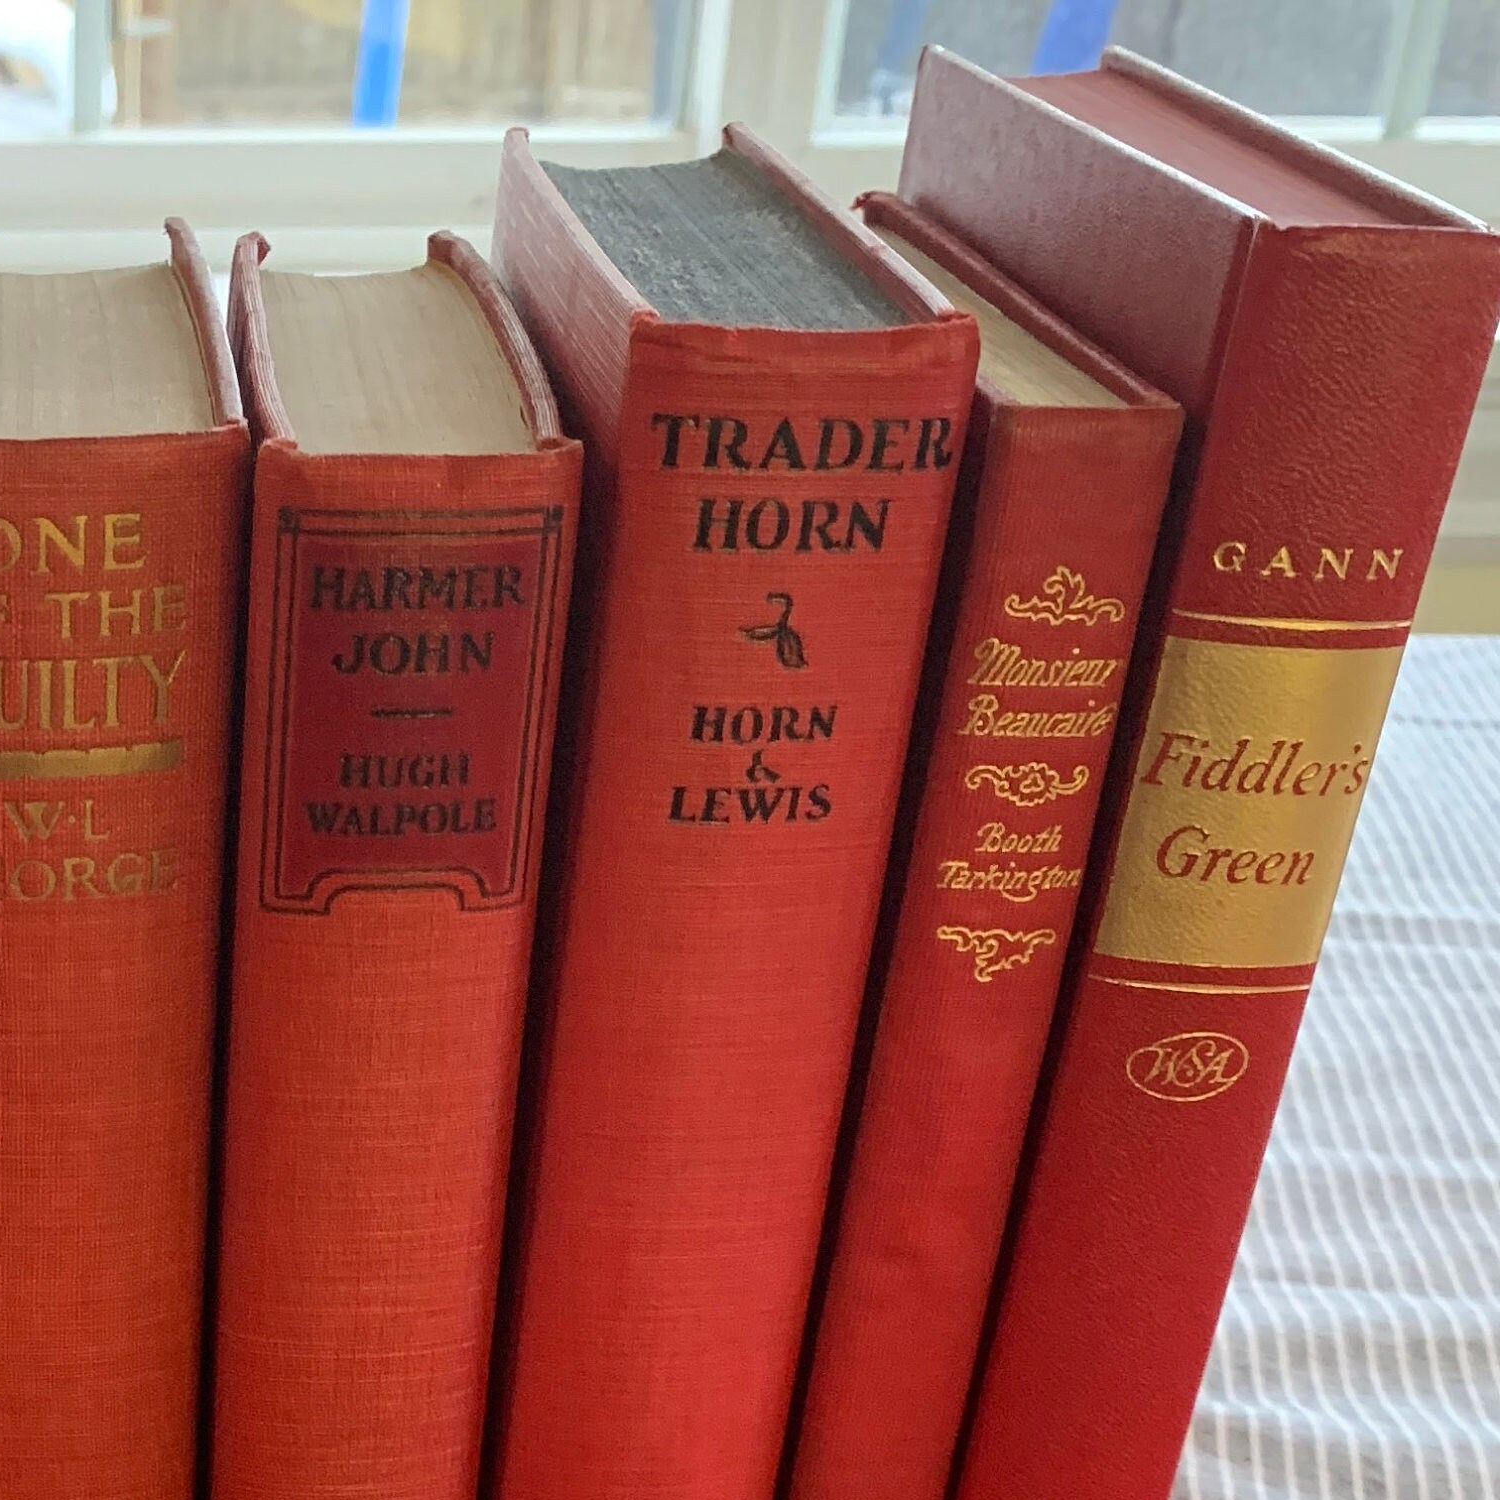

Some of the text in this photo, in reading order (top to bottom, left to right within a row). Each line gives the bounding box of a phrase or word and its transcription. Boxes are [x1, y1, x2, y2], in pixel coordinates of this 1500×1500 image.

[650, 412, 956, 473] TRADER
[692, 495, 892, 553] HORN
[1212, 541, 1405, 581] GANN
[310, 563, 526, 612] HARMER
[44, 584, 187, 640] THE
[332, 630, 493, 676] JOHN
[967, 637, 1122, 687] Monsieur
[689, 704, 839, 743] HORN
[957, 693, 1117, 737] Beaucaire
[339, 753, 470, 790] HUGH
[745, 748, 782, 783] &
[1139, 731, 1366, 797] Fiddler's
[303, 798, 497, 837] WALPOLE
[668, 784, 833, 825] LEWIS
[975, 822, 1062, 852] Booth
[1155, 825, 1316, 887] Green
[936, 861, 1082, 902] Tarkington
